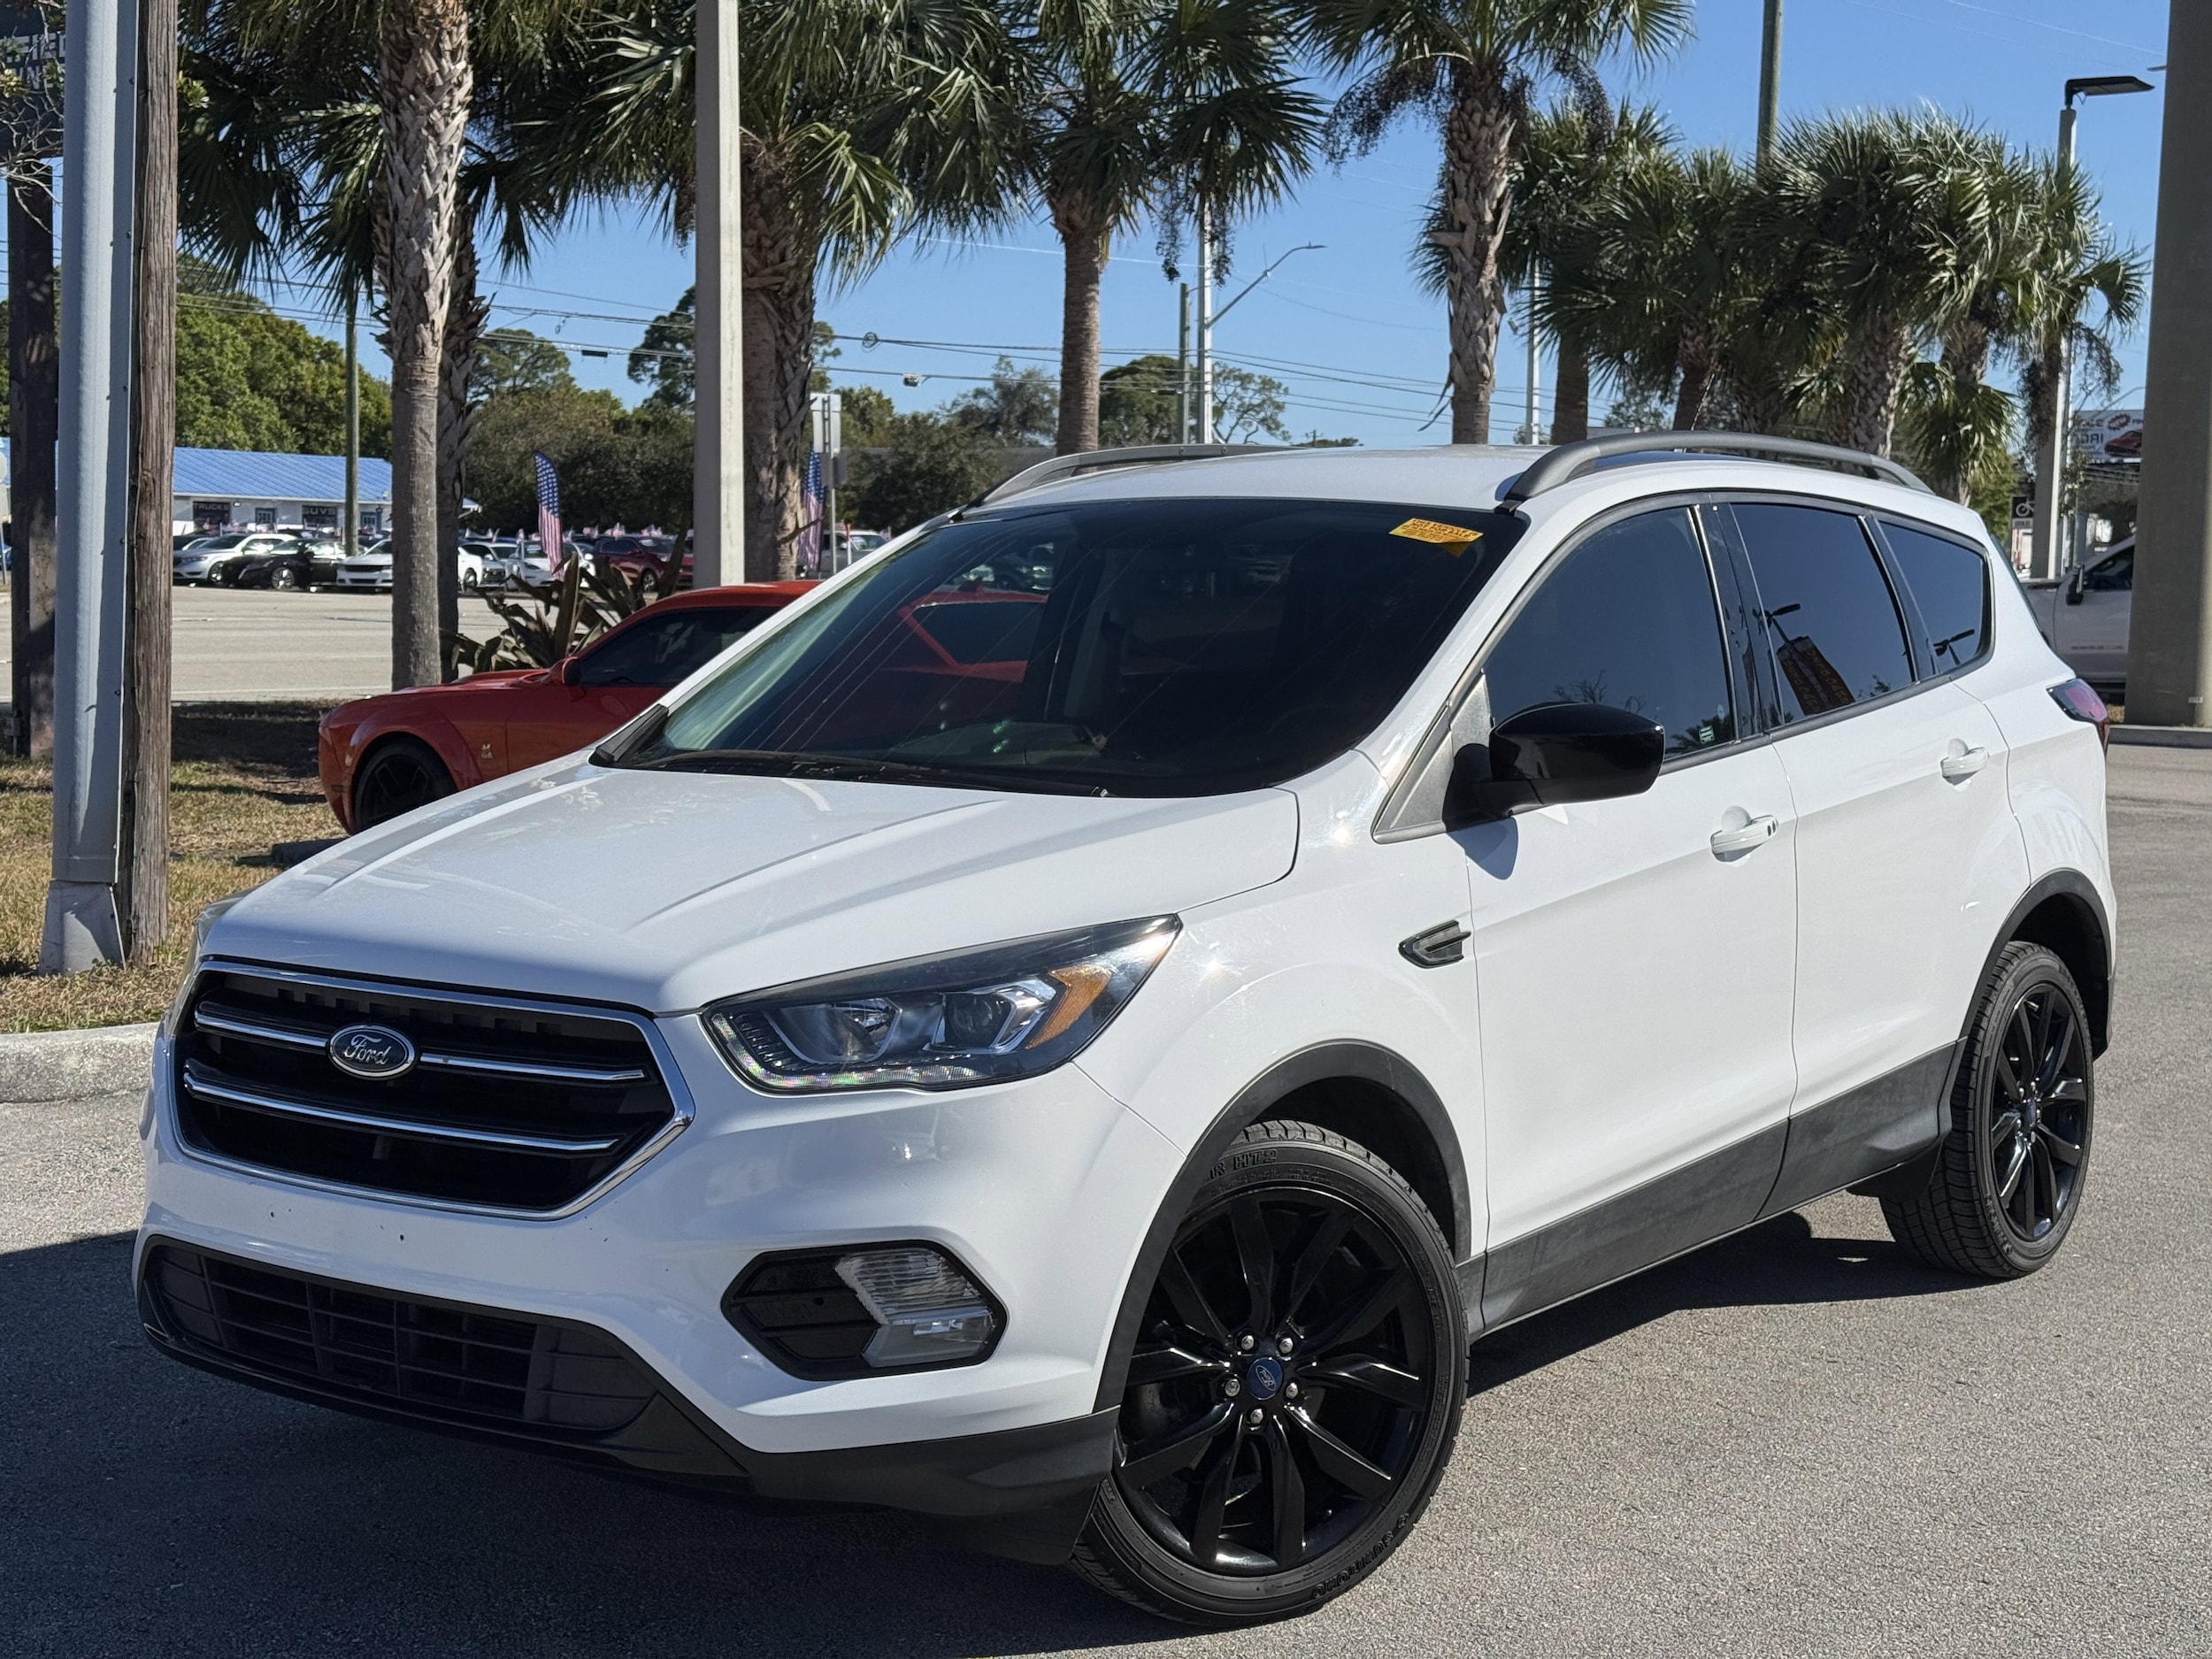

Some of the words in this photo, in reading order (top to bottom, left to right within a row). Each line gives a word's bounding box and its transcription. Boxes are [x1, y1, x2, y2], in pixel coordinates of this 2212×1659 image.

[2109, 416, 2127, 429] NEW
[193, 503, 229, 511] TRUCKS
[302, 506, 336, 515] SUVS
[343, 1033, 392, 1065] Ford
[1233, 1148, 1278, 1170] HT2
